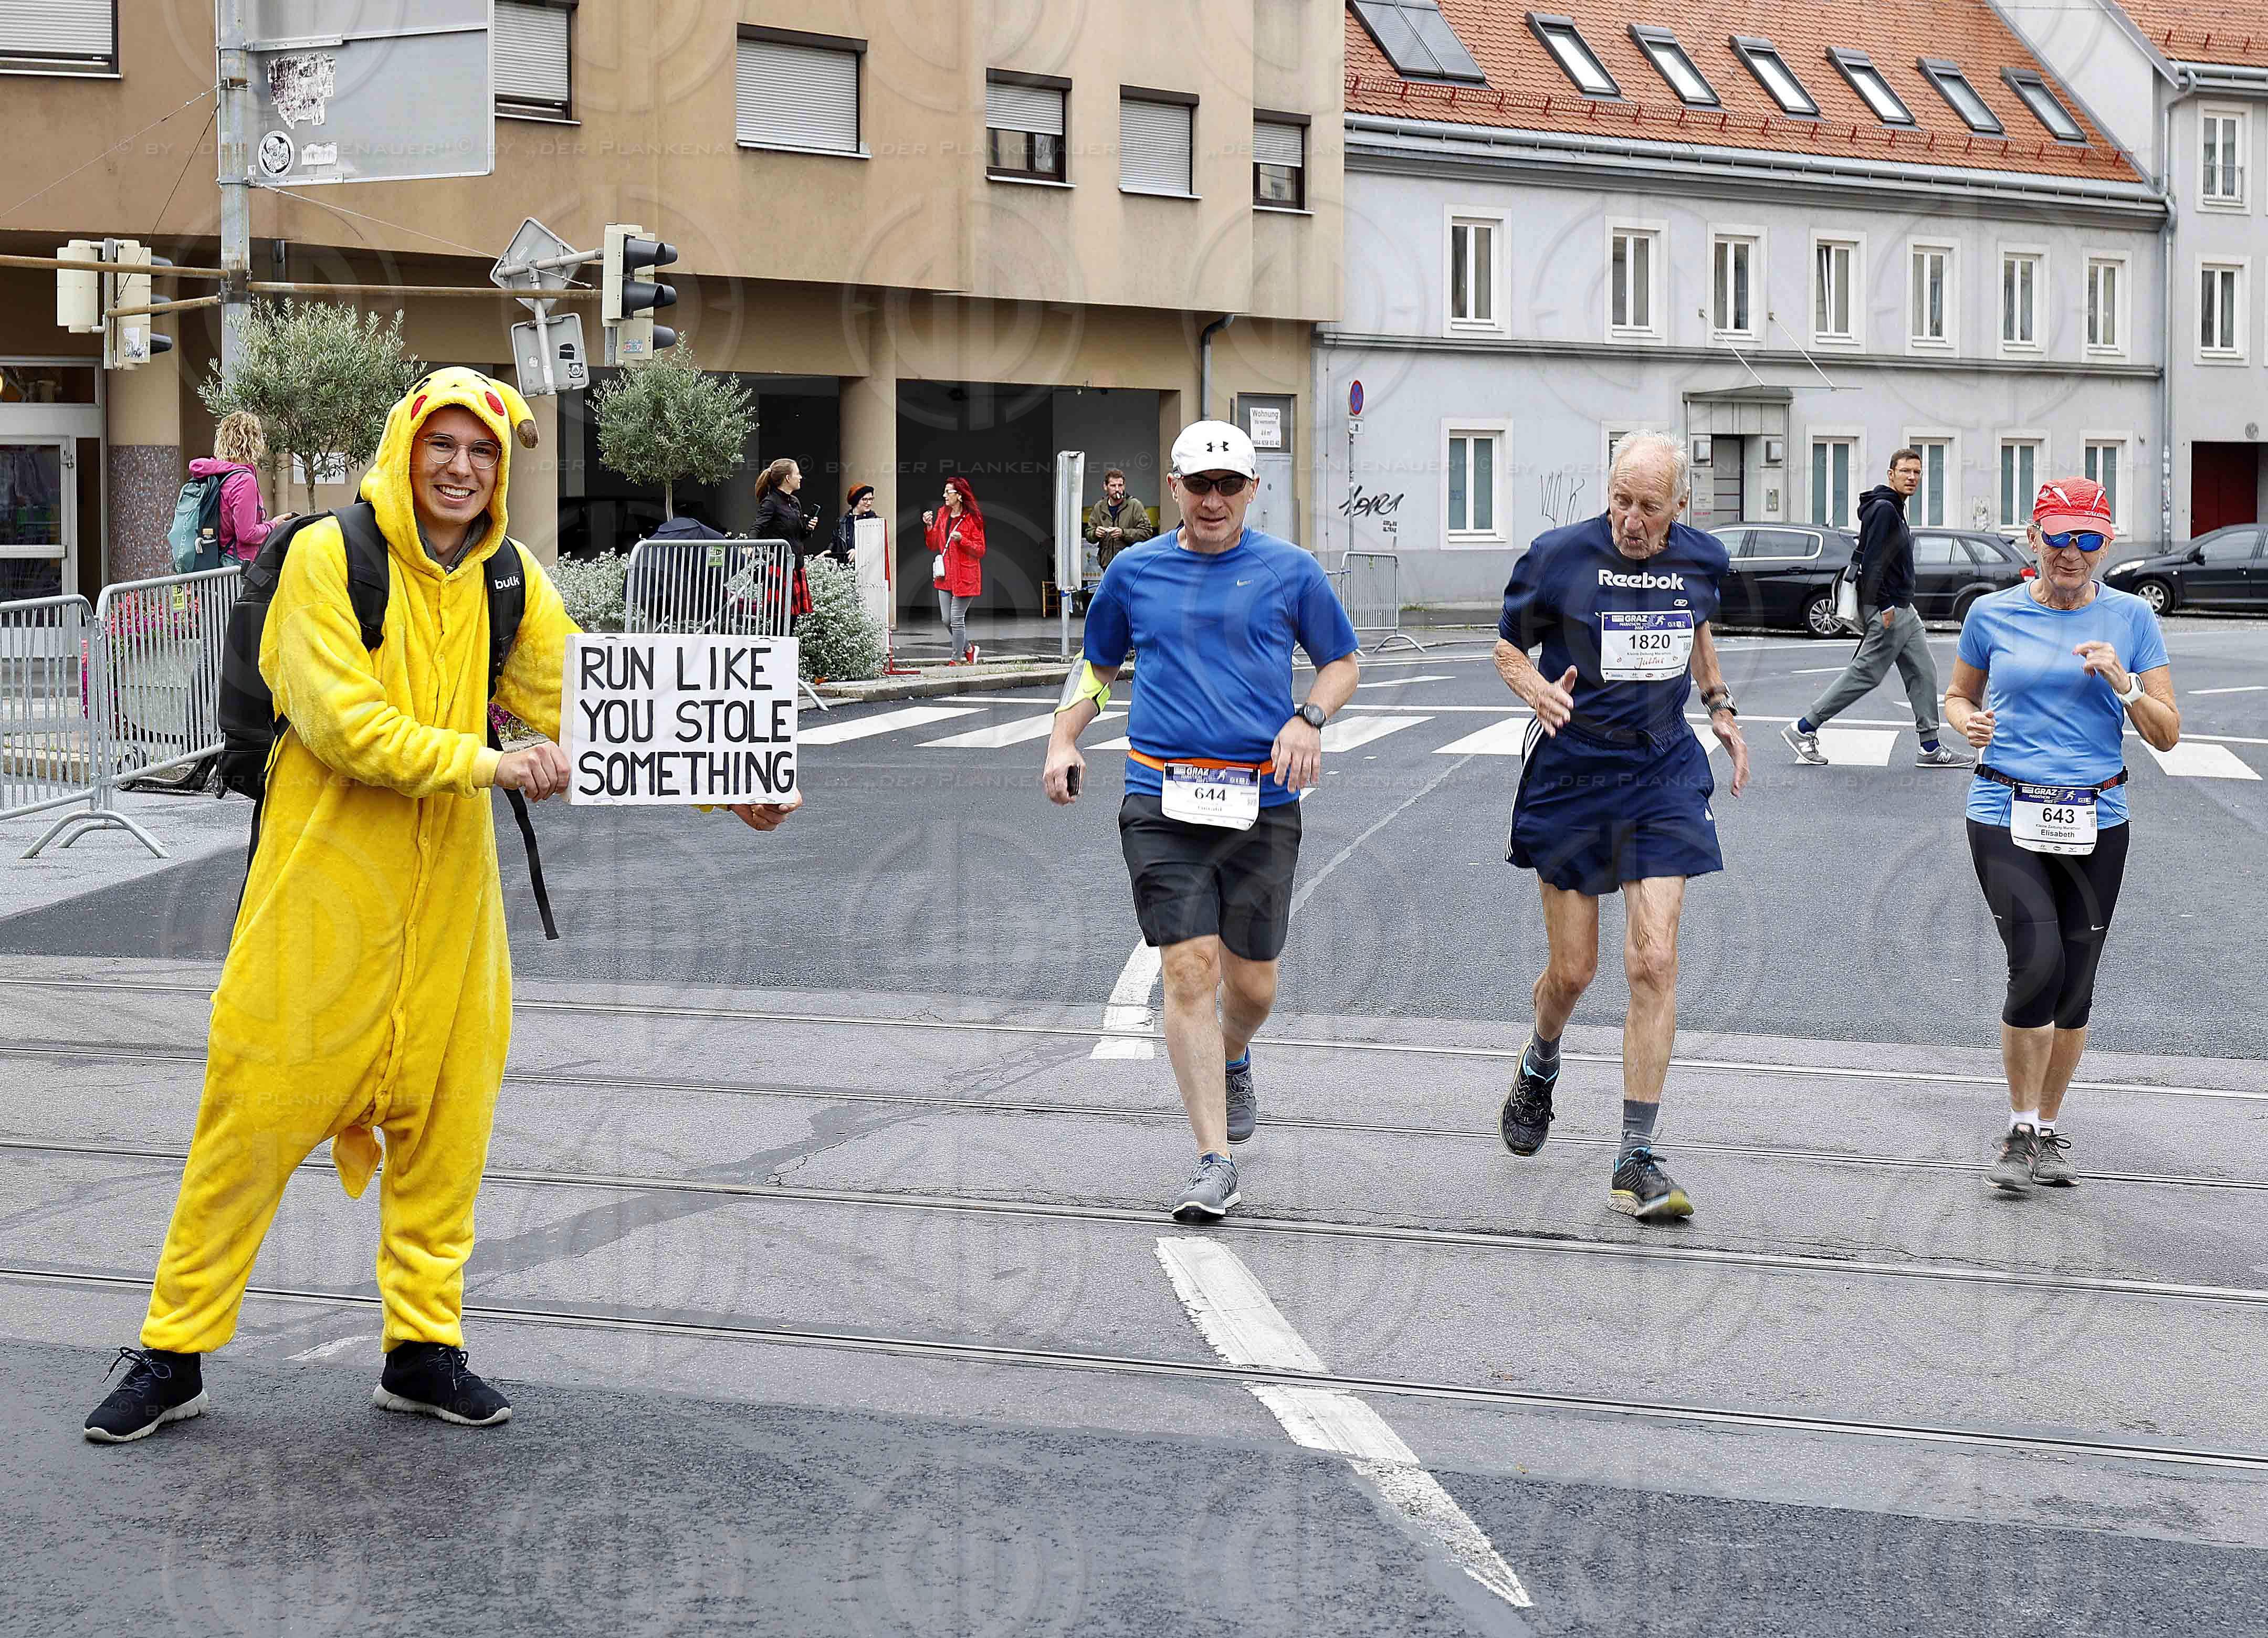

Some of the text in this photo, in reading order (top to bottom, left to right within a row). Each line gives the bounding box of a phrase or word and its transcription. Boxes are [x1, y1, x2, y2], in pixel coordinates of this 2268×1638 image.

[1252, 409, 1279, 419] Wohnung
[495, 575, 520, 590] bulk
[1599, 569, 1685, 591] Reebok
[1629, 634, 1671, 649] 1820
[581, 646, 773, 690] RUN LIKE
[580, 699, 792, 743] YOU STOLE
[579, 751, 794, 796] SOMETHING
[1195, 787, 1226, 801] 644
[2043, 807, 2075, 823] 643
[2041, 830, 2075, 838] Elisabeth
